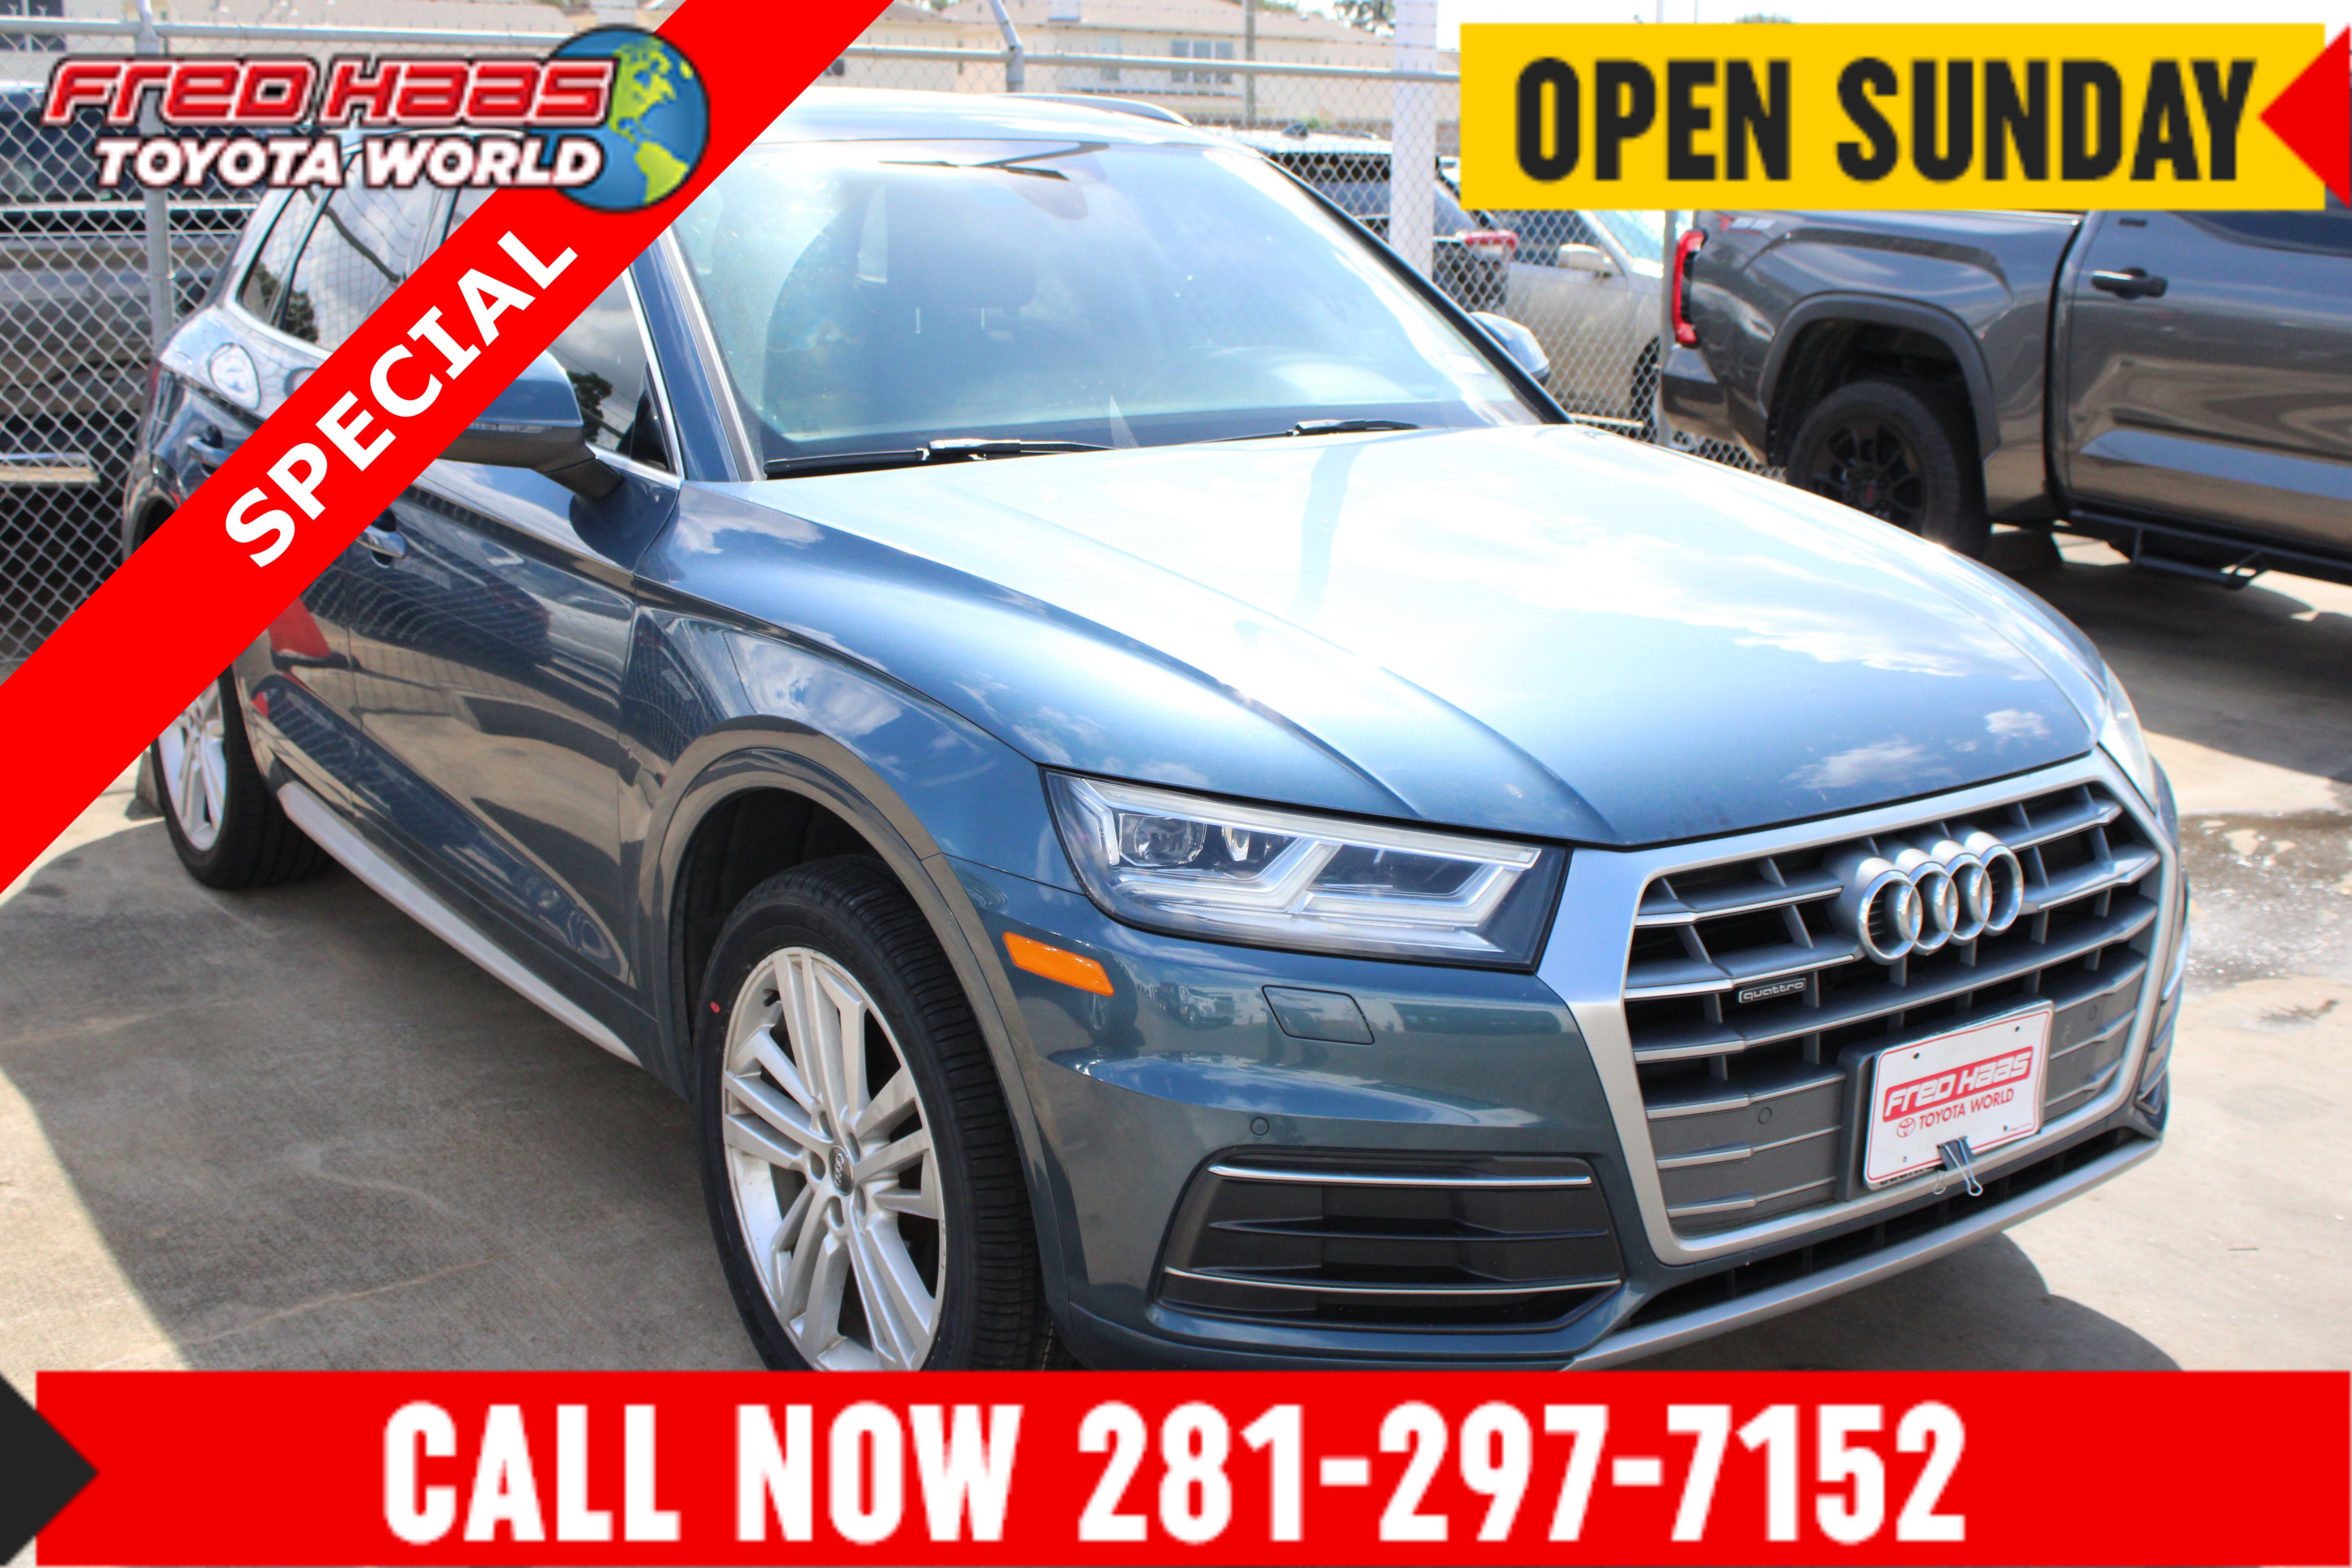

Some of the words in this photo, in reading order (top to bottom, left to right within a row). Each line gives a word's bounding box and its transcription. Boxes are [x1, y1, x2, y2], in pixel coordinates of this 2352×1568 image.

[1743, 982, 1804, 1000] quattro
[1919, 1104, 1966, 1130] TOYOTA
[1971, 1088, 2015, 1113] WORLD
